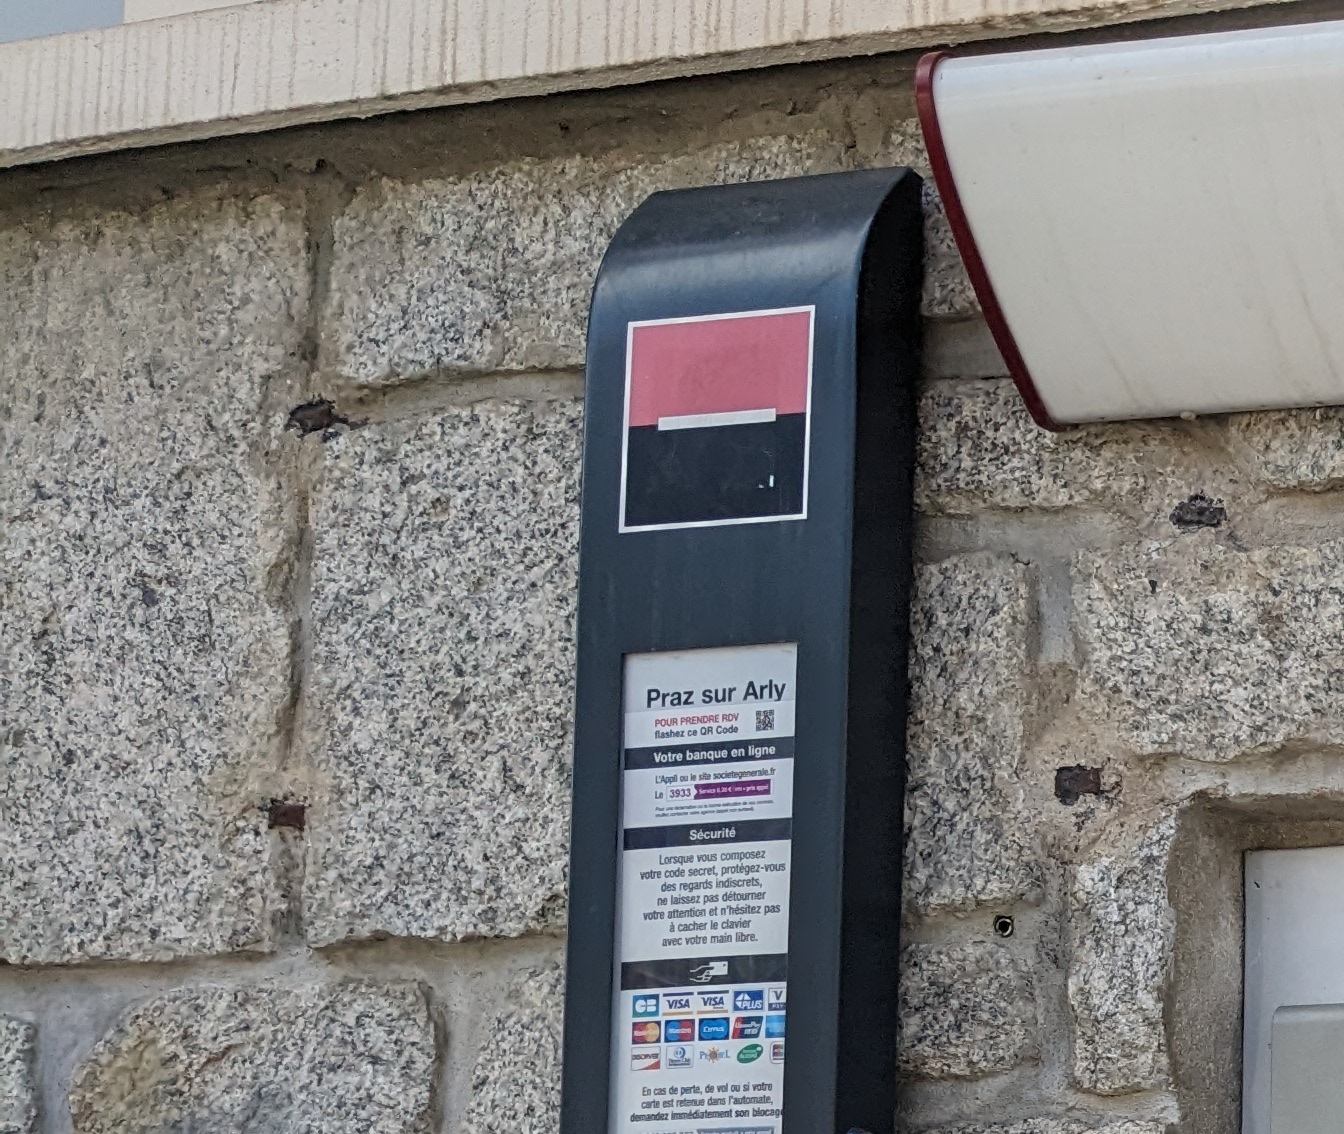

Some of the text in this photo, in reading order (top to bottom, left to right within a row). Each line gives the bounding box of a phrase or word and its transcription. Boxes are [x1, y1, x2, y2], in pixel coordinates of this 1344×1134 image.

[646, 679, 786, 708] Praz sur Arly
[654, 713, 739, 728] POUR PRENDRE RDV
[654, 730, 684, 739] flashez
[700, 727, 713, 735] QR
[716, 725, 738, 734] Code
[653, 745, 776, 763] Votre banque en ligne
[690, 773, 697, 781] le
[698, 772, 711, 781] site
[655, 788, 691, 799] Le 3933
[689, 827, 736, 840] Sécurité
[659, 850, 766, 866] Lorsque vous composez
[640, 862, 786, 879] votre code secret, protégez-vous
[661, 877, 763, 892] des regards indiscrets,
[657, 891, 766, 906] ne laissez pas détourner
[643, 904, 780, 920] votre attention et n'hésitez pas
[669, 919, 752, 932] à cacher le clavier
[662, 932, 758, 946] avec votre main libre.
[701, 996, 724, 1006] VISA
[774, 991, 783, 1000] V
[666, 999, 690, 1009] VISA
[742, 1001, 762, 1009] PLUS
[642, 1082, 772, 1096] En cas de perte, de vol ou si votre
[641, 1095, 773, 1109] carte est retenue dans l'automate,
[630, 1112, 669, 1122] demandez
[671, 1109, 732, 1120] immédiatement
[735, 1109, 750, 1118] son
